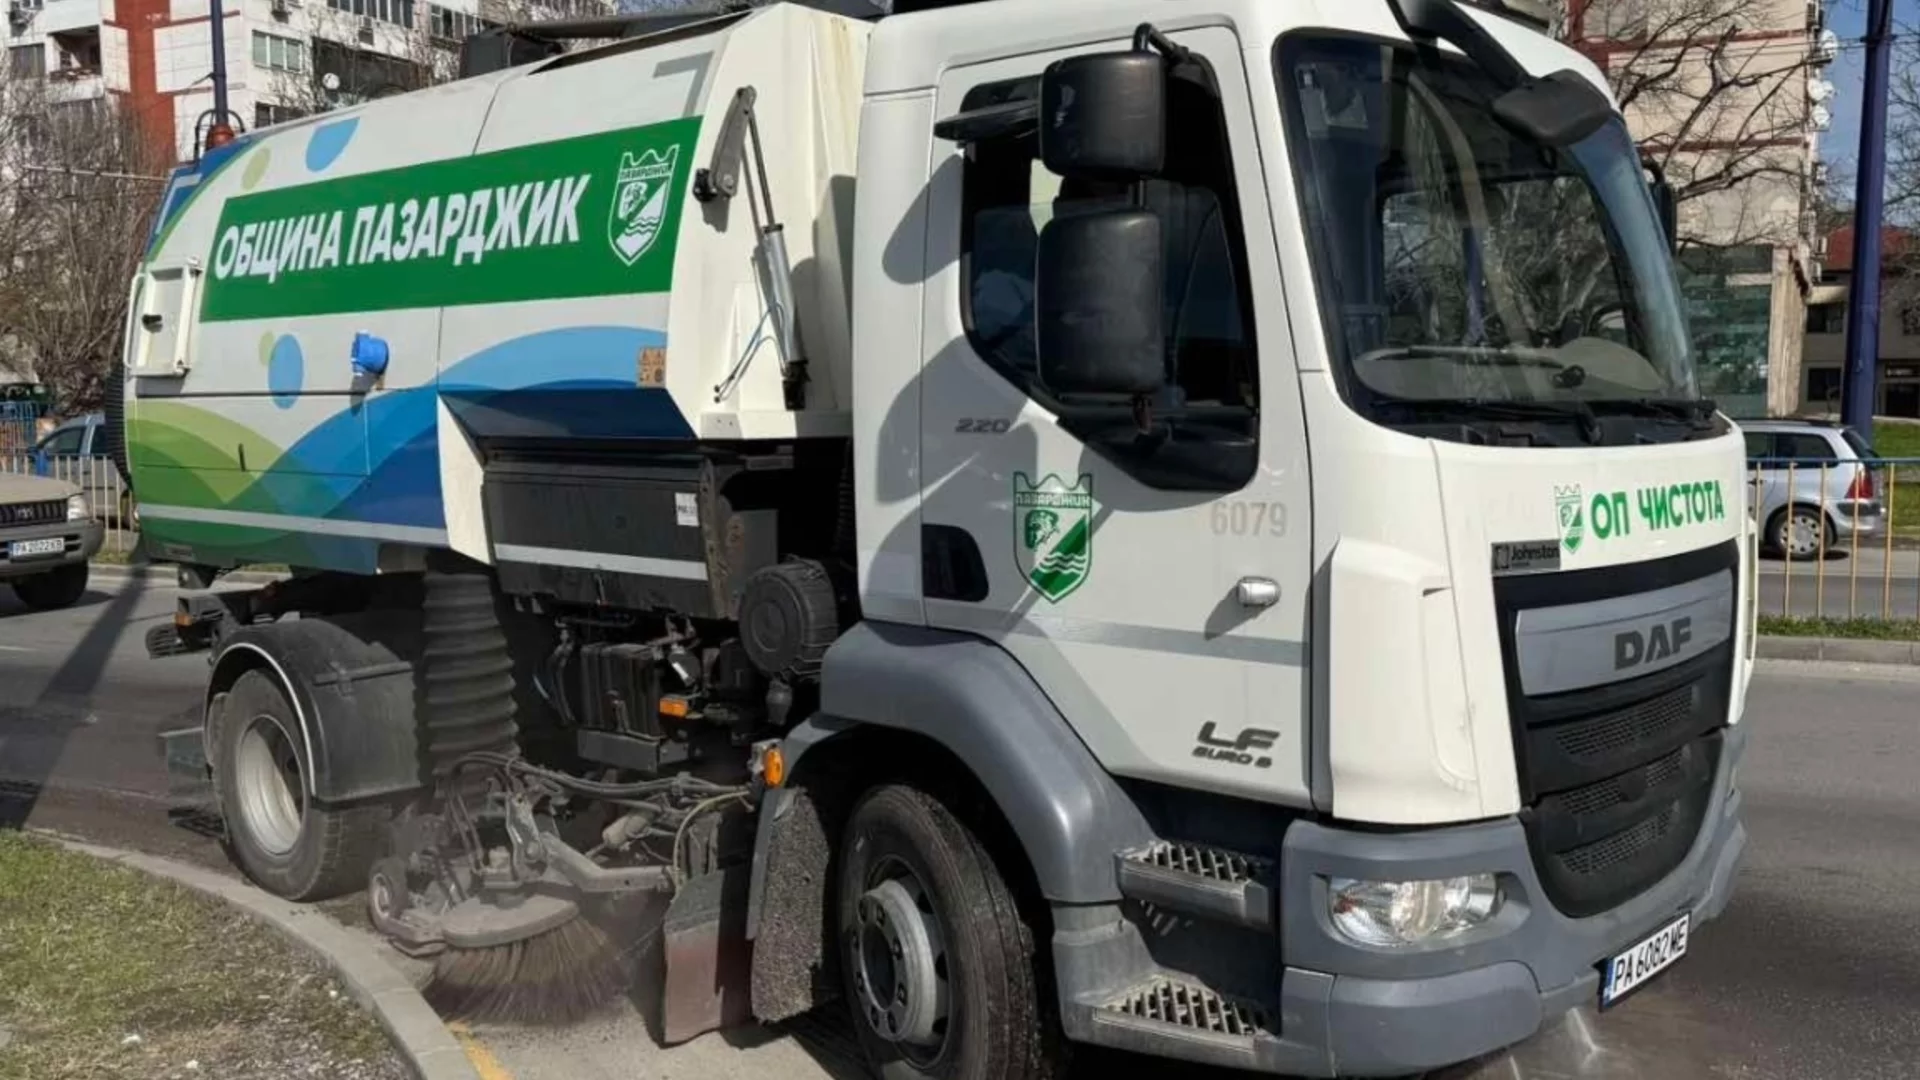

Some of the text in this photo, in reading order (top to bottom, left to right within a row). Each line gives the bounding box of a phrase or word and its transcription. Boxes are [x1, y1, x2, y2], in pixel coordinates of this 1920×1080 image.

[214, 174, 592, 284] ОБЩИНА ПАЗАРДЖИК
[955, 417, 1010, 433] 220
[1211, 501, 1287, 537] 6079
[1591, 480, 1724, 539] ОП ЧИСТОТА
[1511, 544, 1560, 560] Johnston
[1614, 616, 1692, 671] DAF
[1198, 720, 1280, 751] LF
[1192, 746, 1253, 765] EURO
